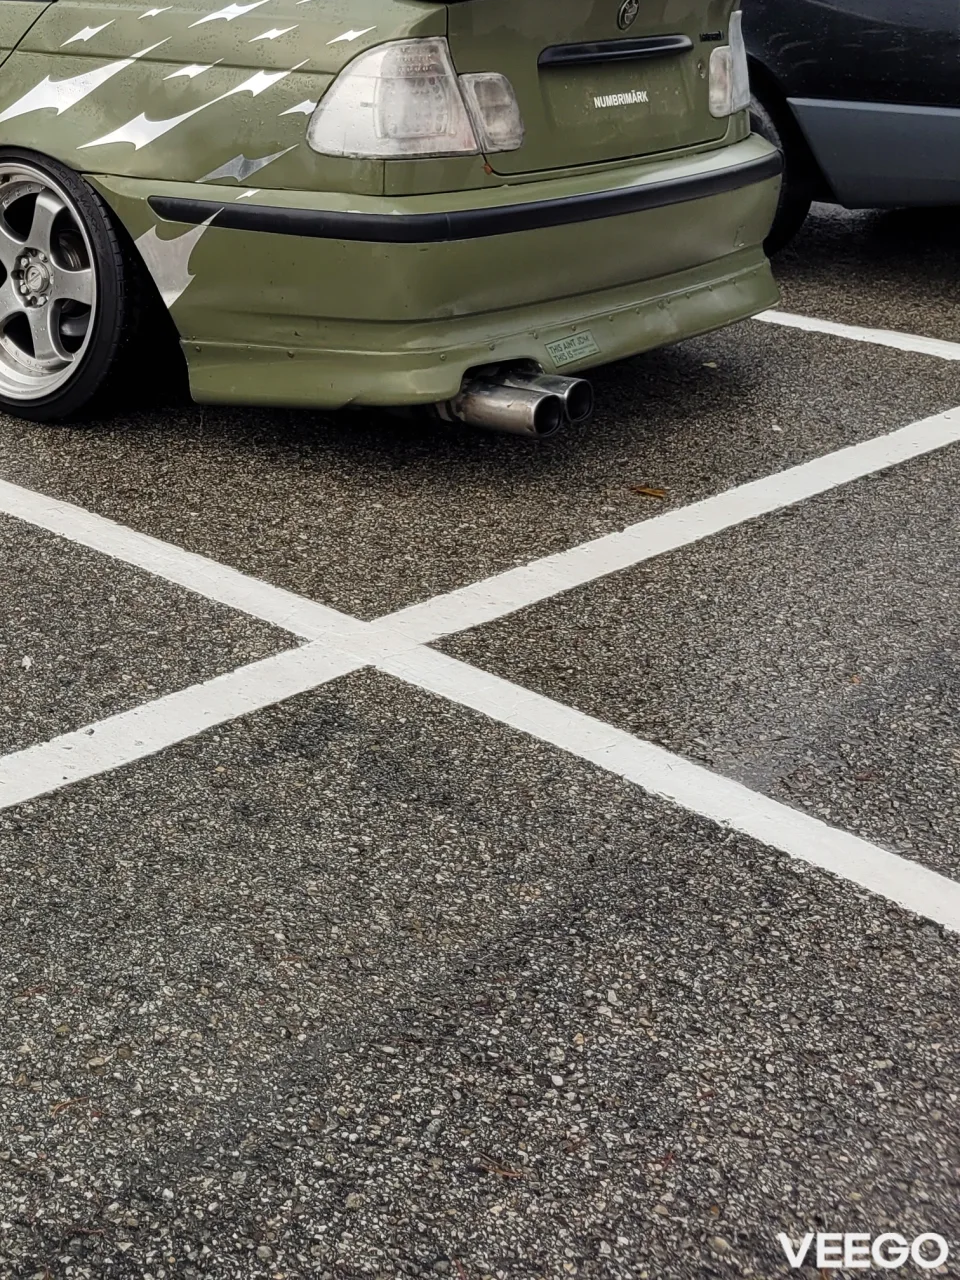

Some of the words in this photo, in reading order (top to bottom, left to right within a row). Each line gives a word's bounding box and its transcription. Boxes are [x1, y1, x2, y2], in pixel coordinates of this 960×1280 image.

[548, 343, 563, 354] THIS
[553, 353, 568, 363] THIS
[566, 350, 574, 359] IS
